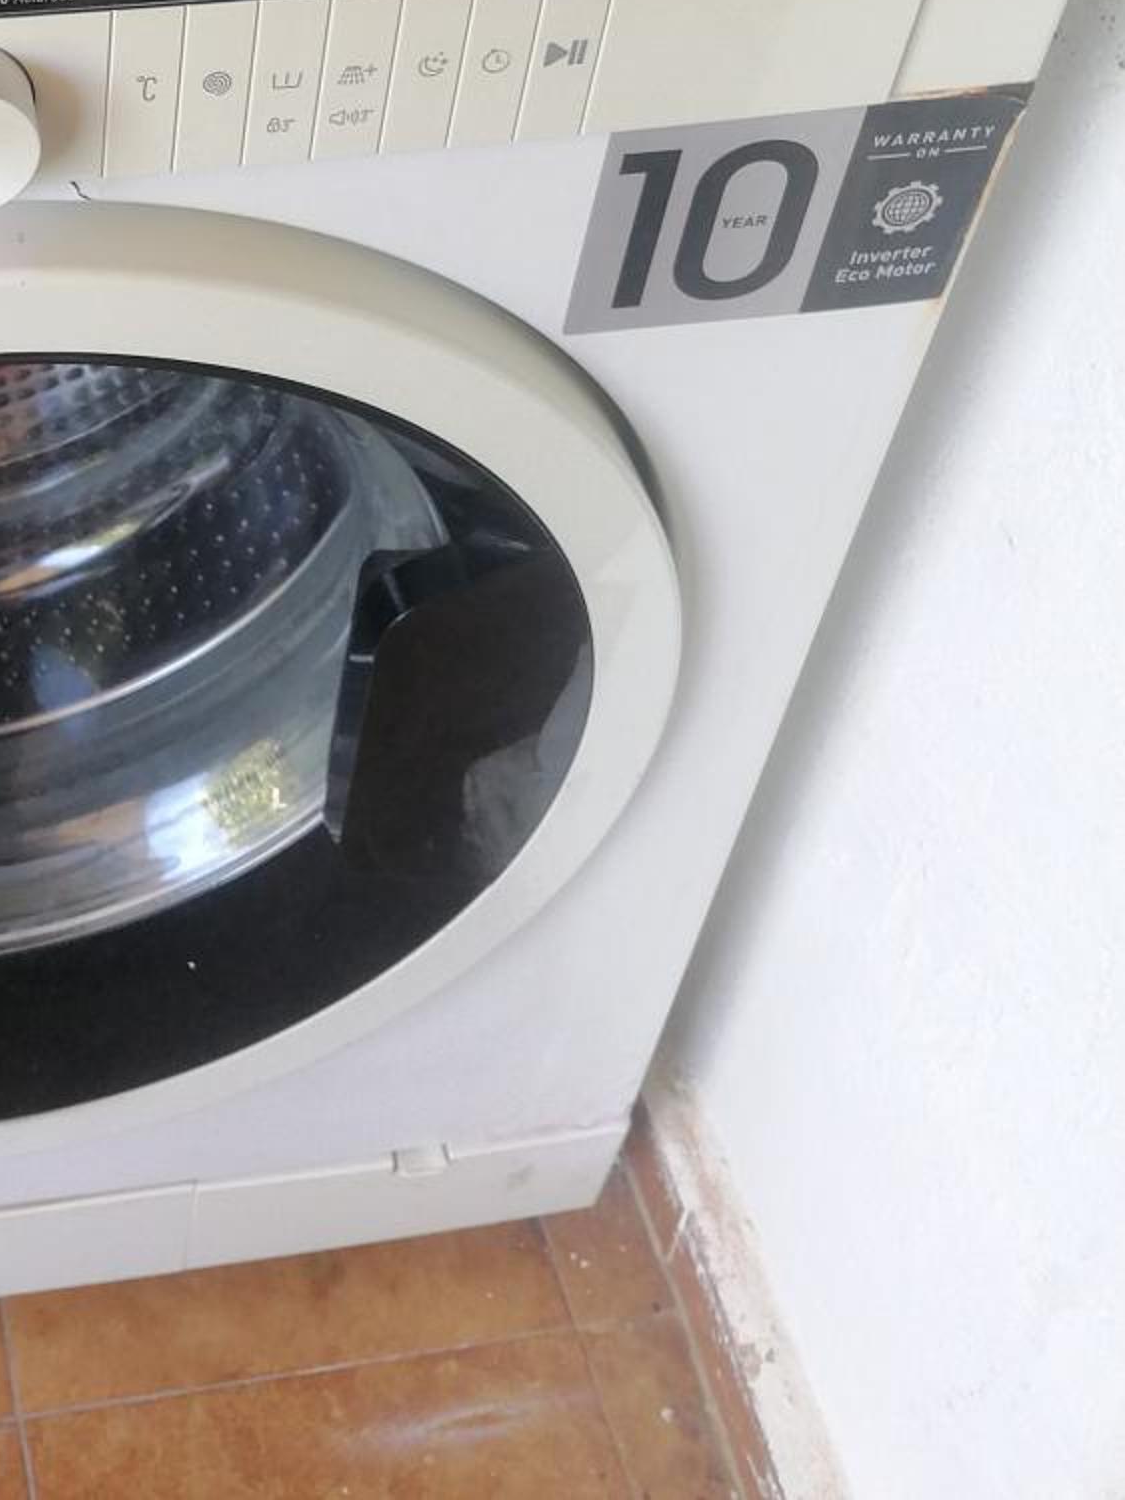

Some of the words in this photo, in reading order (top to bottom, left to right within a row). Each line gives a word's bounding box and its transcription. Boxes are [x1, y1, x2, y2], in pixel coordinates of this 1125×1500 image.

[874, 125, 996, 148] WARRANTY
[916, 147, 941, 160] ON
[612, 139, 820, 309] 10
[721, 213, 769, 230] YEAR
[849, 245, 934, 266] Inverter
[835, 269, 871, 284] Eco
[875, 262, 937, 280] Motor
